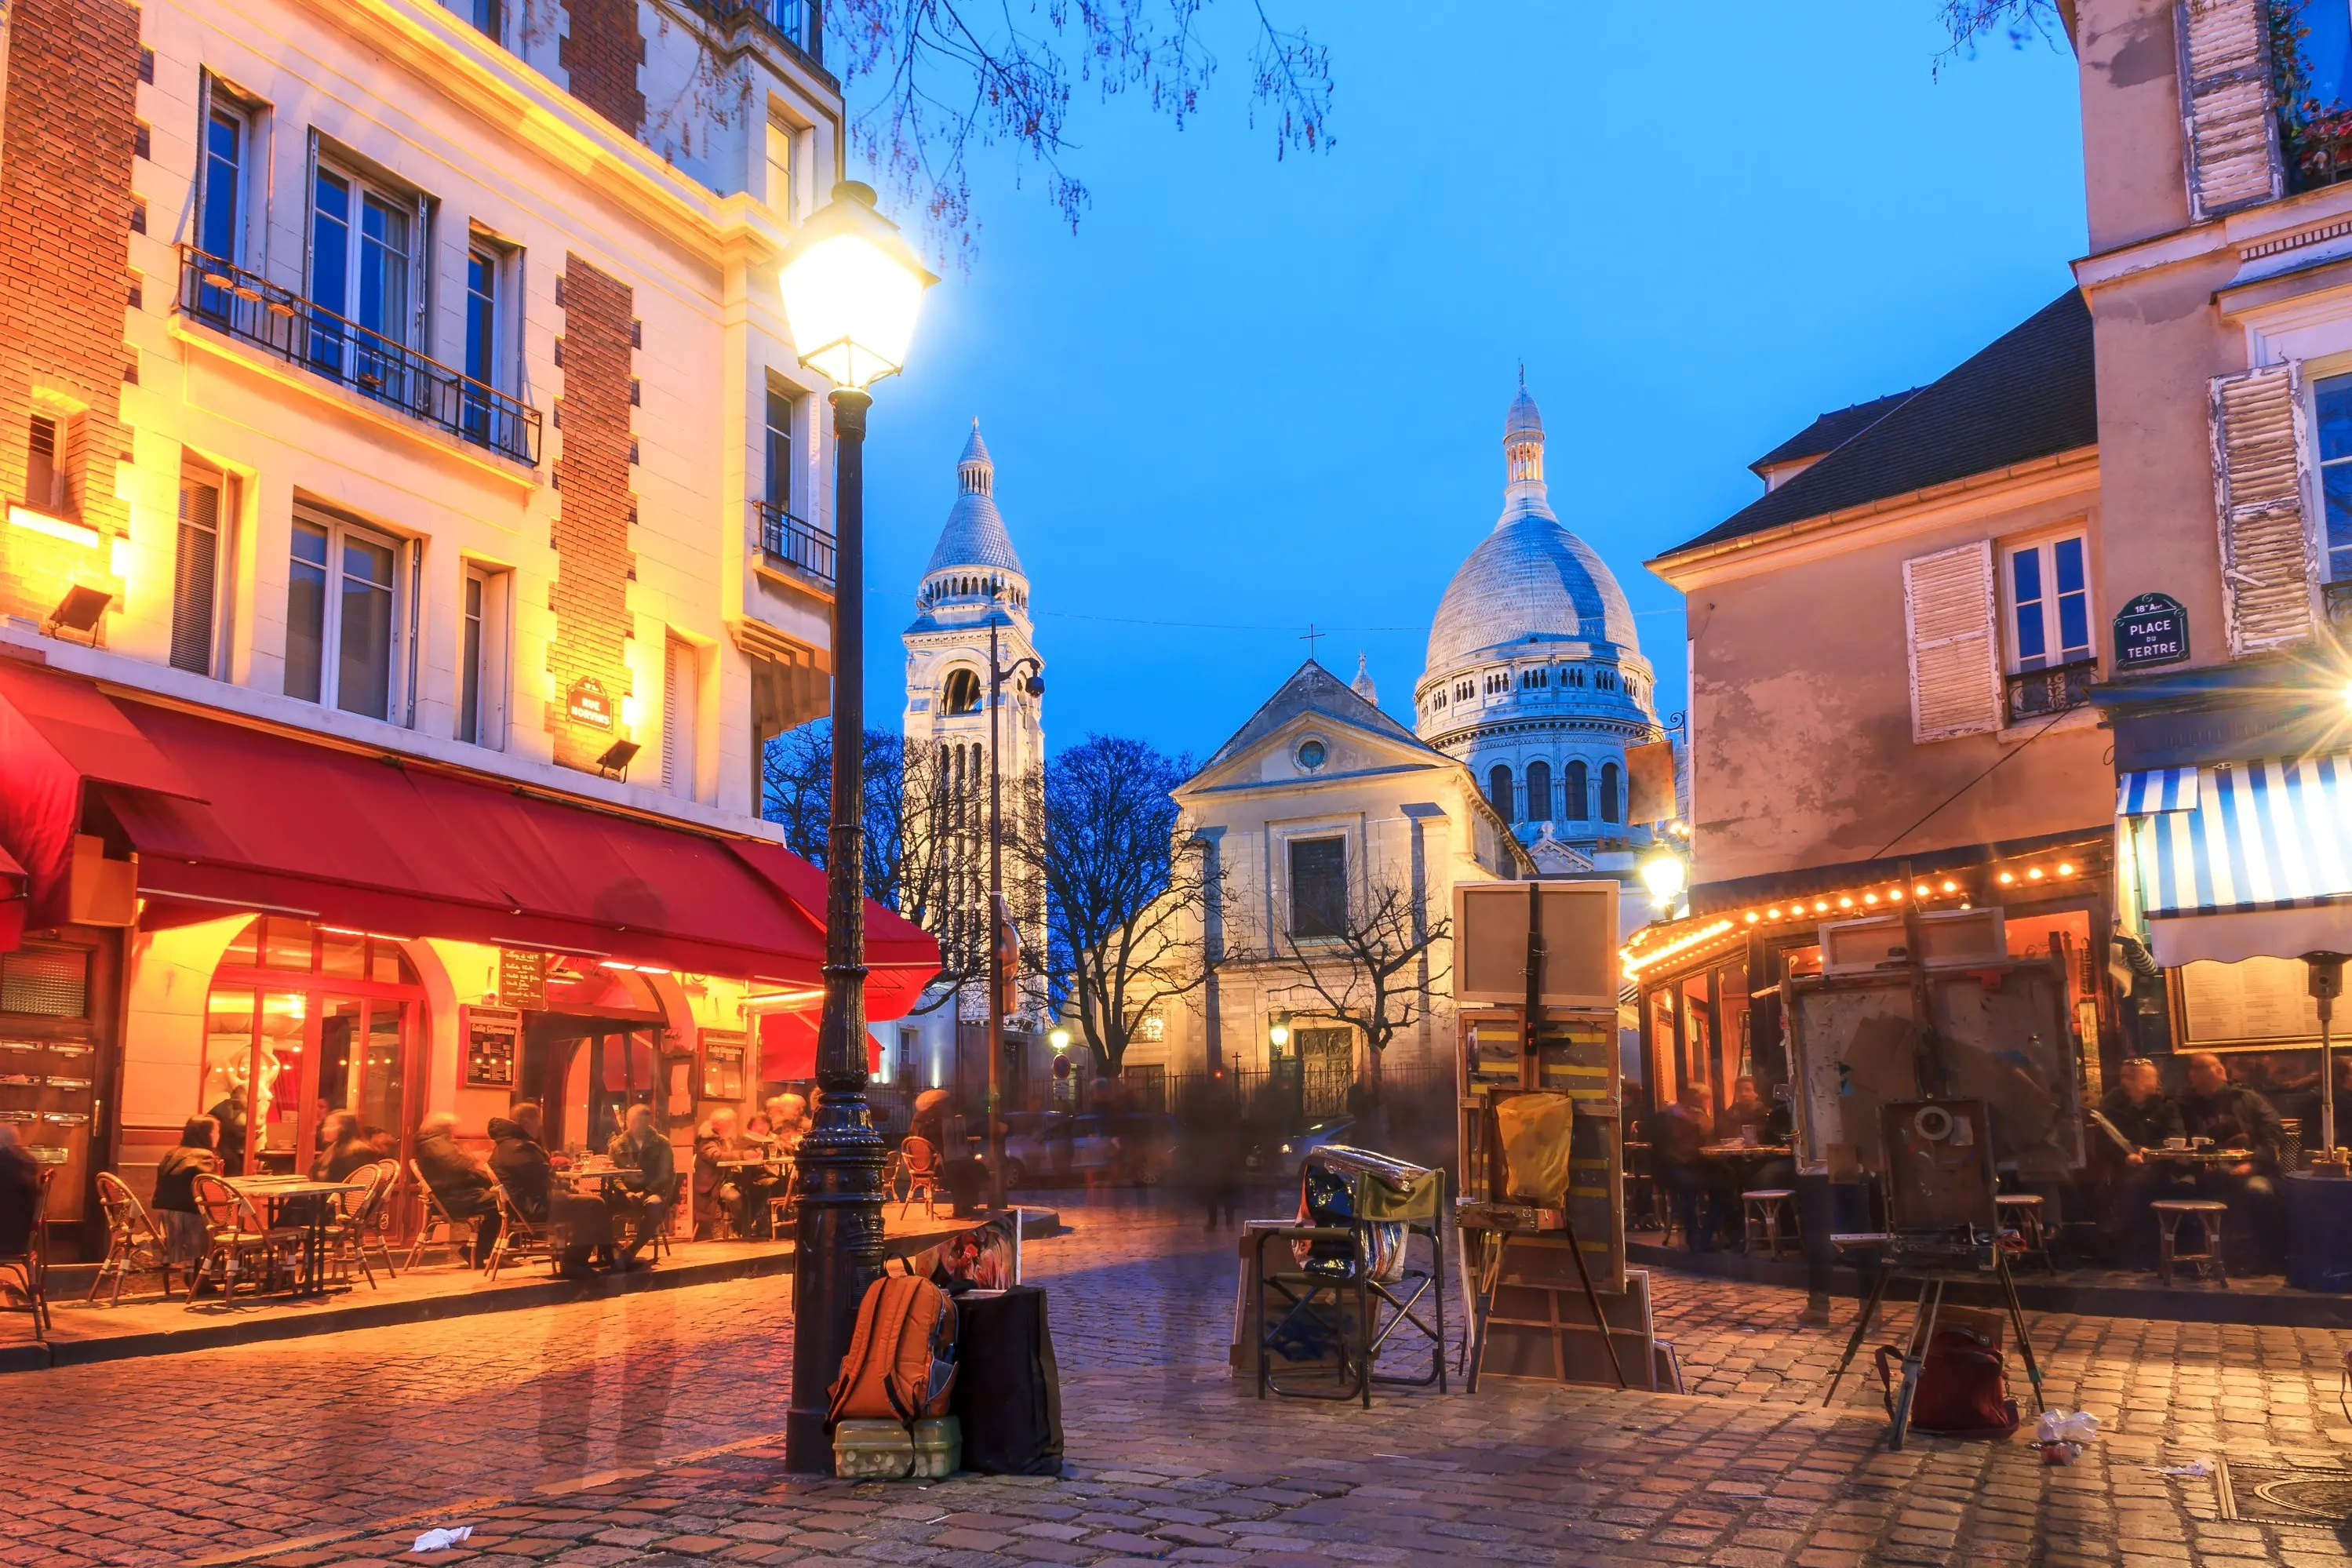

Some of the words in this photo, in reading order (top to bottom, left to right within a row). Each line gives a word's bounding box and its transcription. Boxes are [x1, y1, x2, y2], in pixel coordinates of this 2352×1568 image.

[2130, 620, 2172, 636] PLACE
[2128, 642, 2177, 658] TERTRE
[581, 696, 601, 711] RUE
